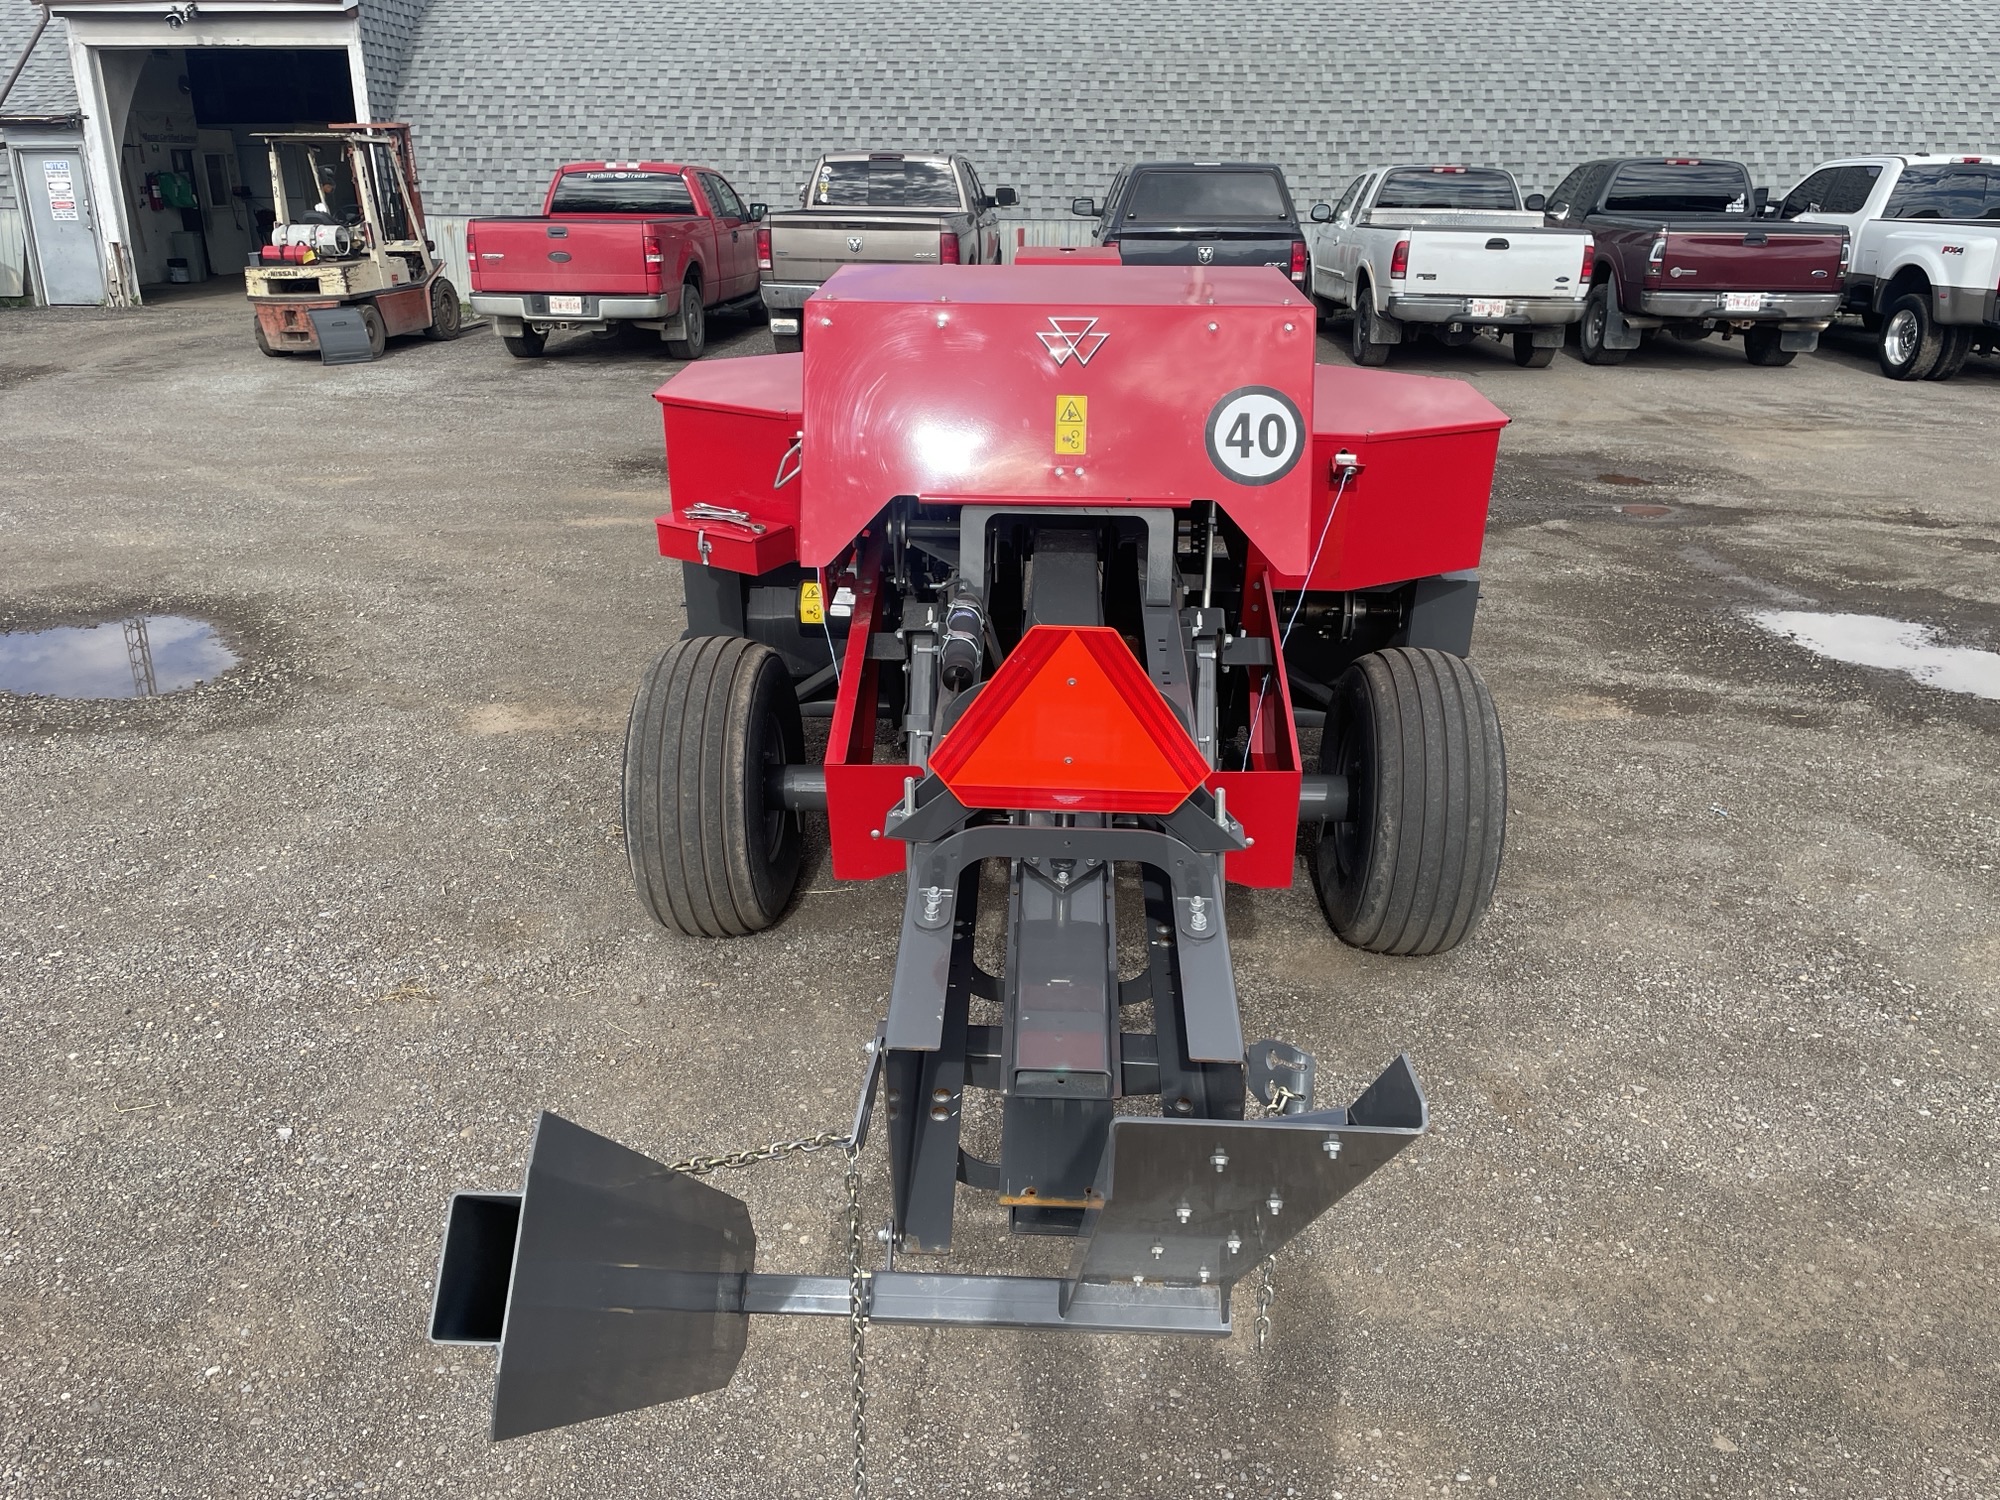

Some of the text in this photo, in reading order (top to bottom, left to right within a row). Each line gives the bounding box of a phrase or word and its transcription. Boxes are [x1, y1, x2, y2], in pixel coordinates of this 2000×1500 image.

[407, 141, 417, 180] NISSAN
[1942, 246, 1965, 254] FX4
[1225, 413, 1287, 459] 40
